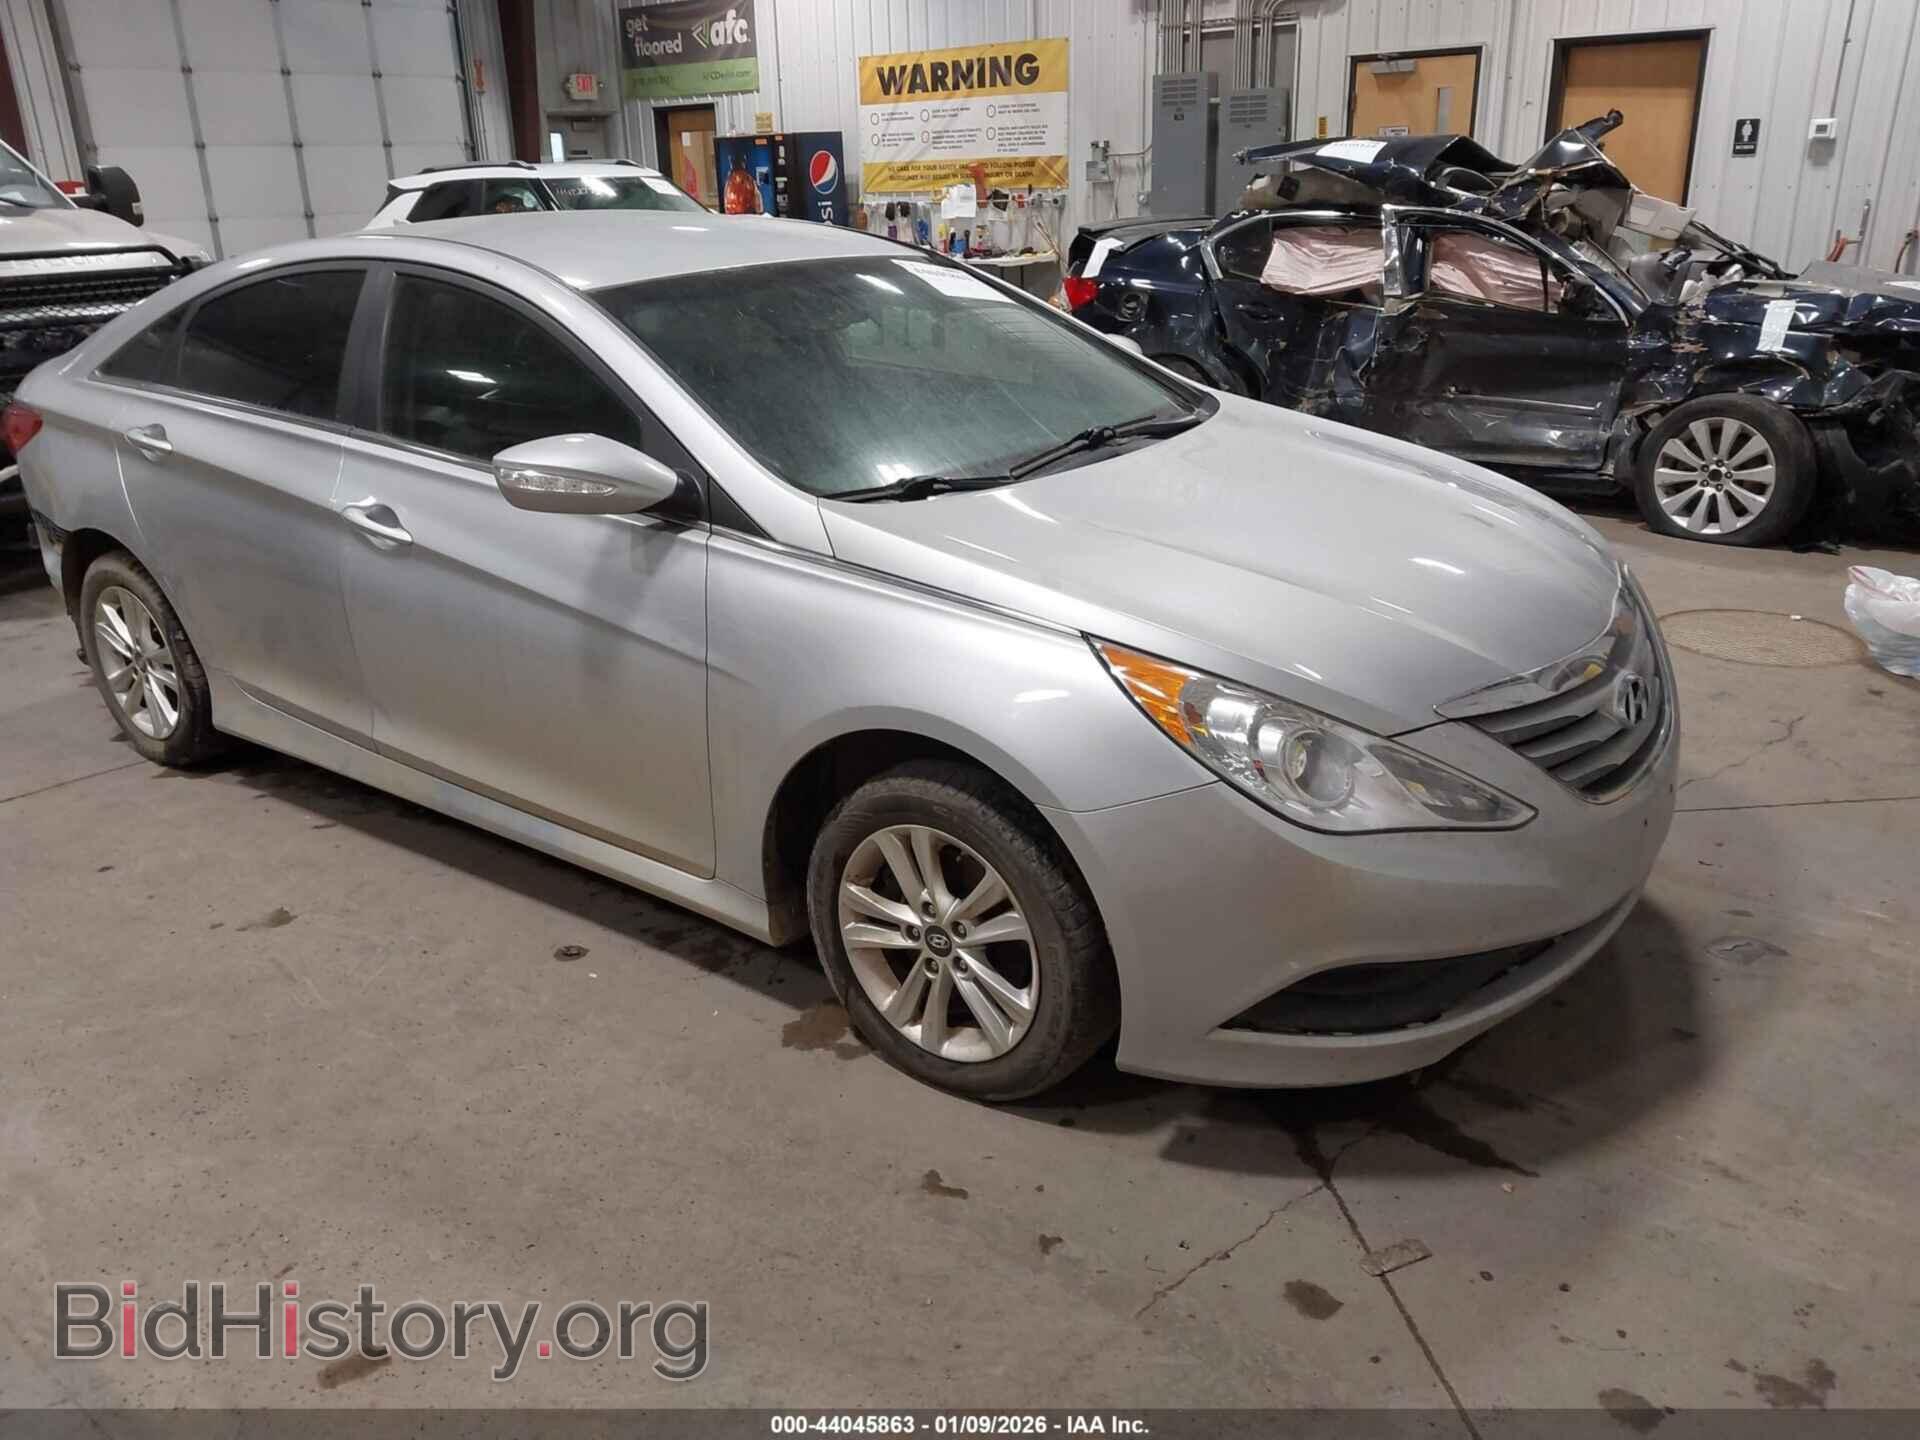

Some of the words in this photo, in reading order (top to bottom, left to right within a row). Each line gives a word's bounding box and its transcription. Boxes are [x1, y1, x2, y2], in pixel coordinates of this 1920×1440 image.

[625, 14, 649, 38] get
[710, 9, 748, 46] afc
[634, 32, 683, 57] floored
[876, 53, 1040, 96] WARNING
